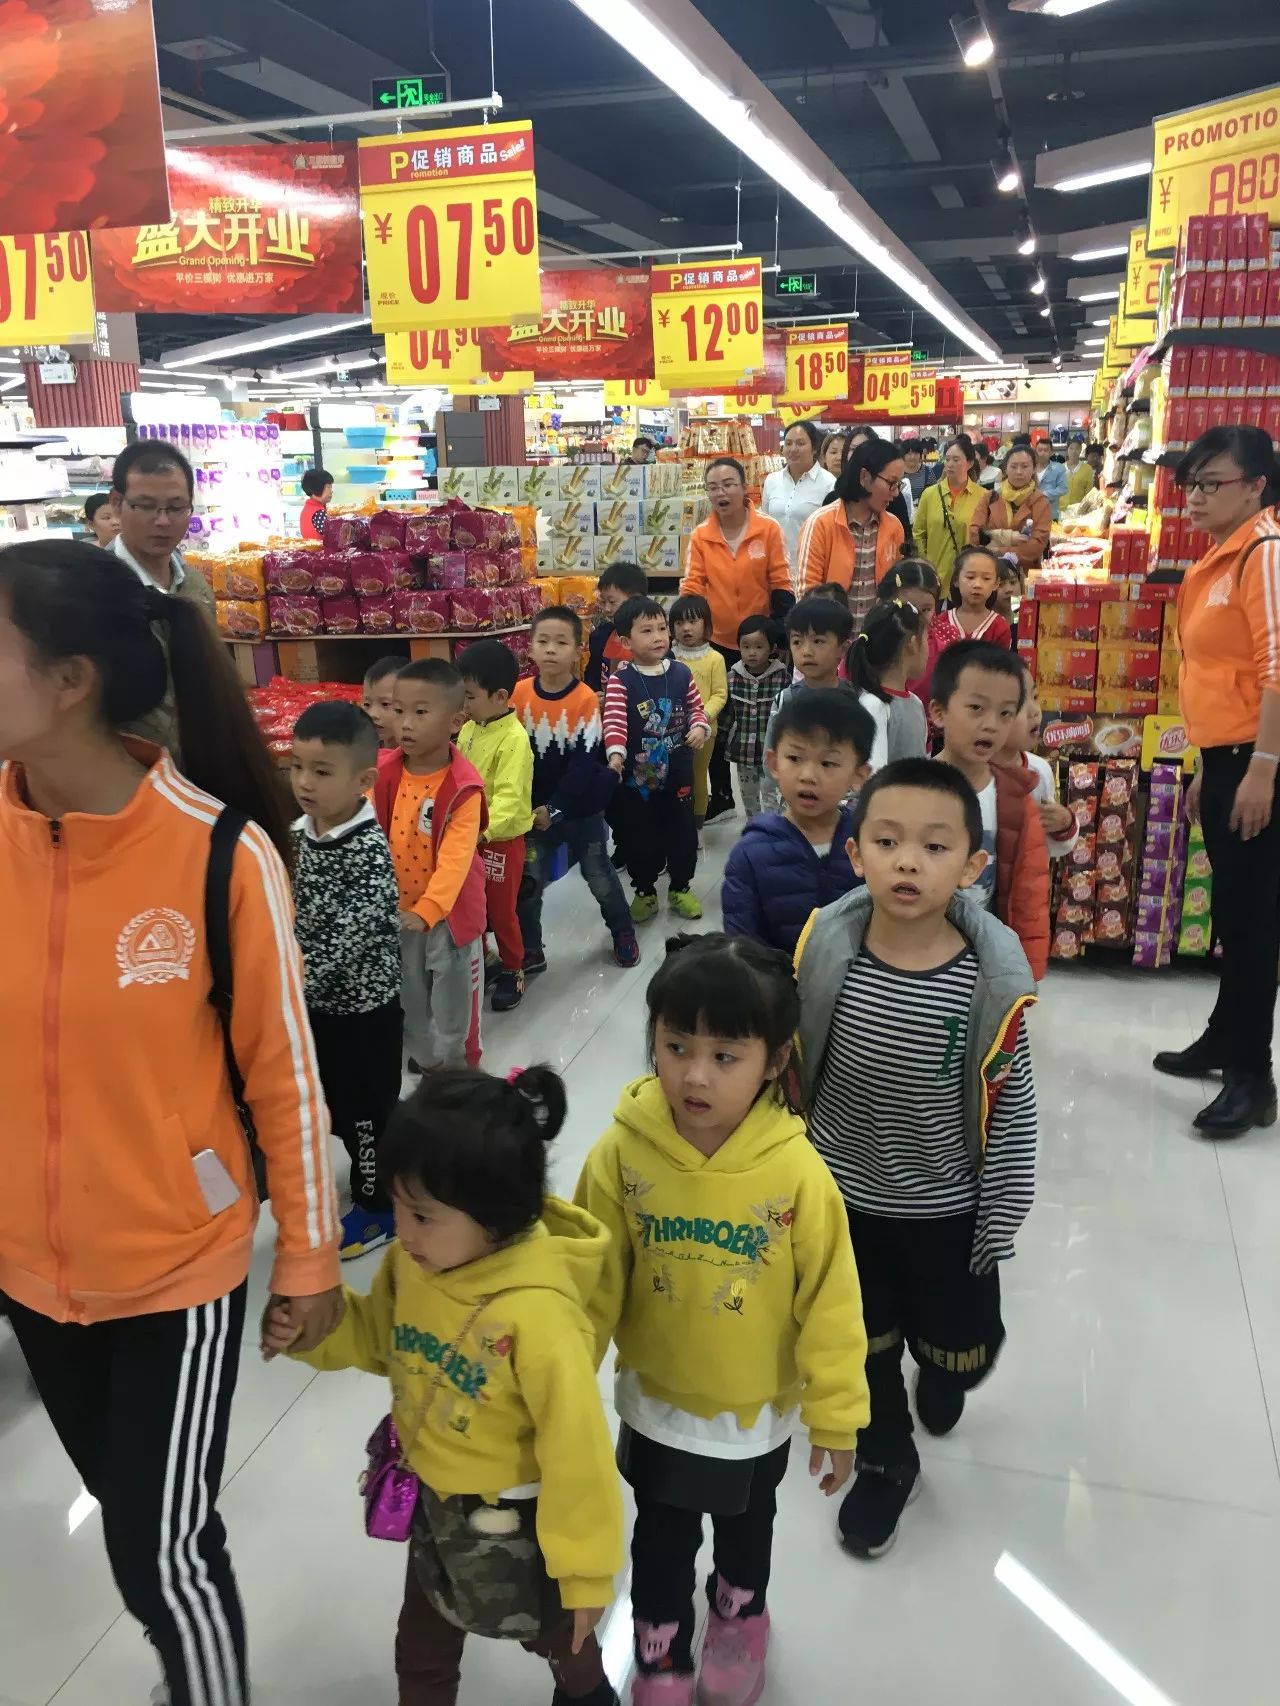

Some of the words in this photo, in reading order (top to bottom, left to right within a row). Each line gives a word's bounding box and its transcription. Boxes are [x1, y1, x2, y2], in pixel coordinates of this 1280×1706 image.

[411, 142, 497, 170] 促销商品
[132, 208, 315, 265] 盛大开业
[179, 256, 206, 266] Grand
[208, 255, 245, 267] Opening
[0, 231, 88, 323] 7.50
[684, 269, 738, 285] 促销商品
